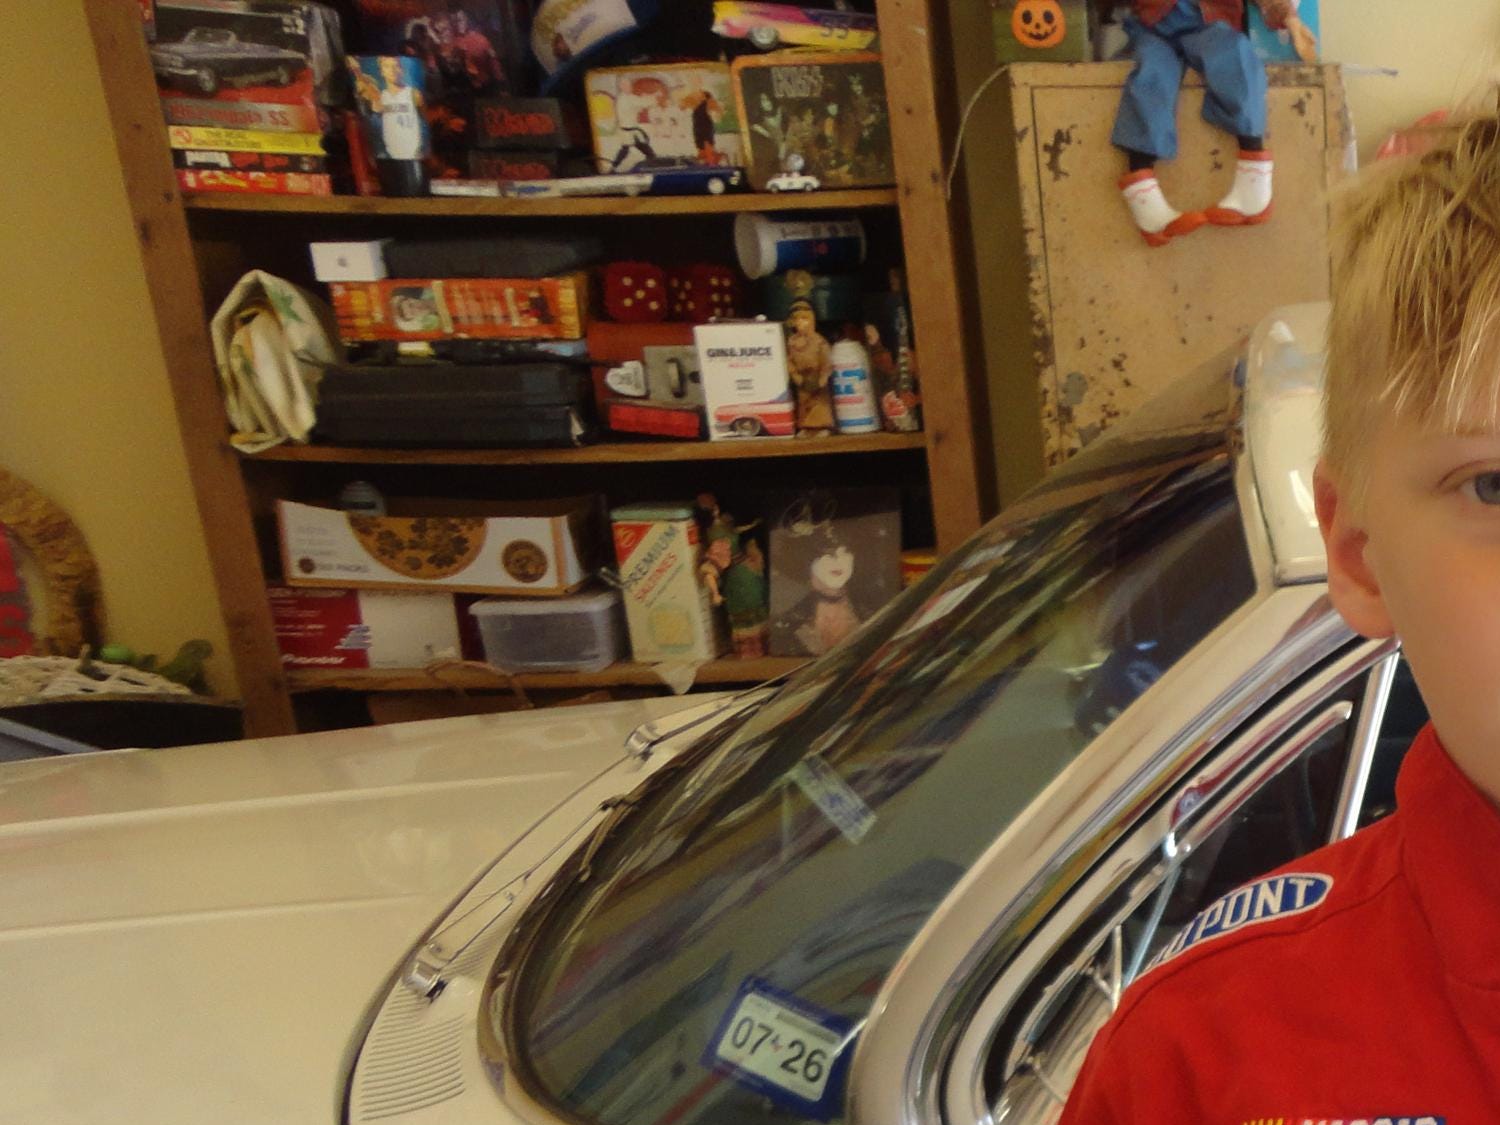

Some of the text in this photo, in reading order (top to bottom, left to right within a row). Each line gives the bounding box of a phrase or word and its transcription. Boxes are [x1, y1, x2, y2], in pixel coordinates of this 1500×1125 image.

[1192, 877, 1315, 942] PONT
[732, 1017, 827, 1083] 07 26
